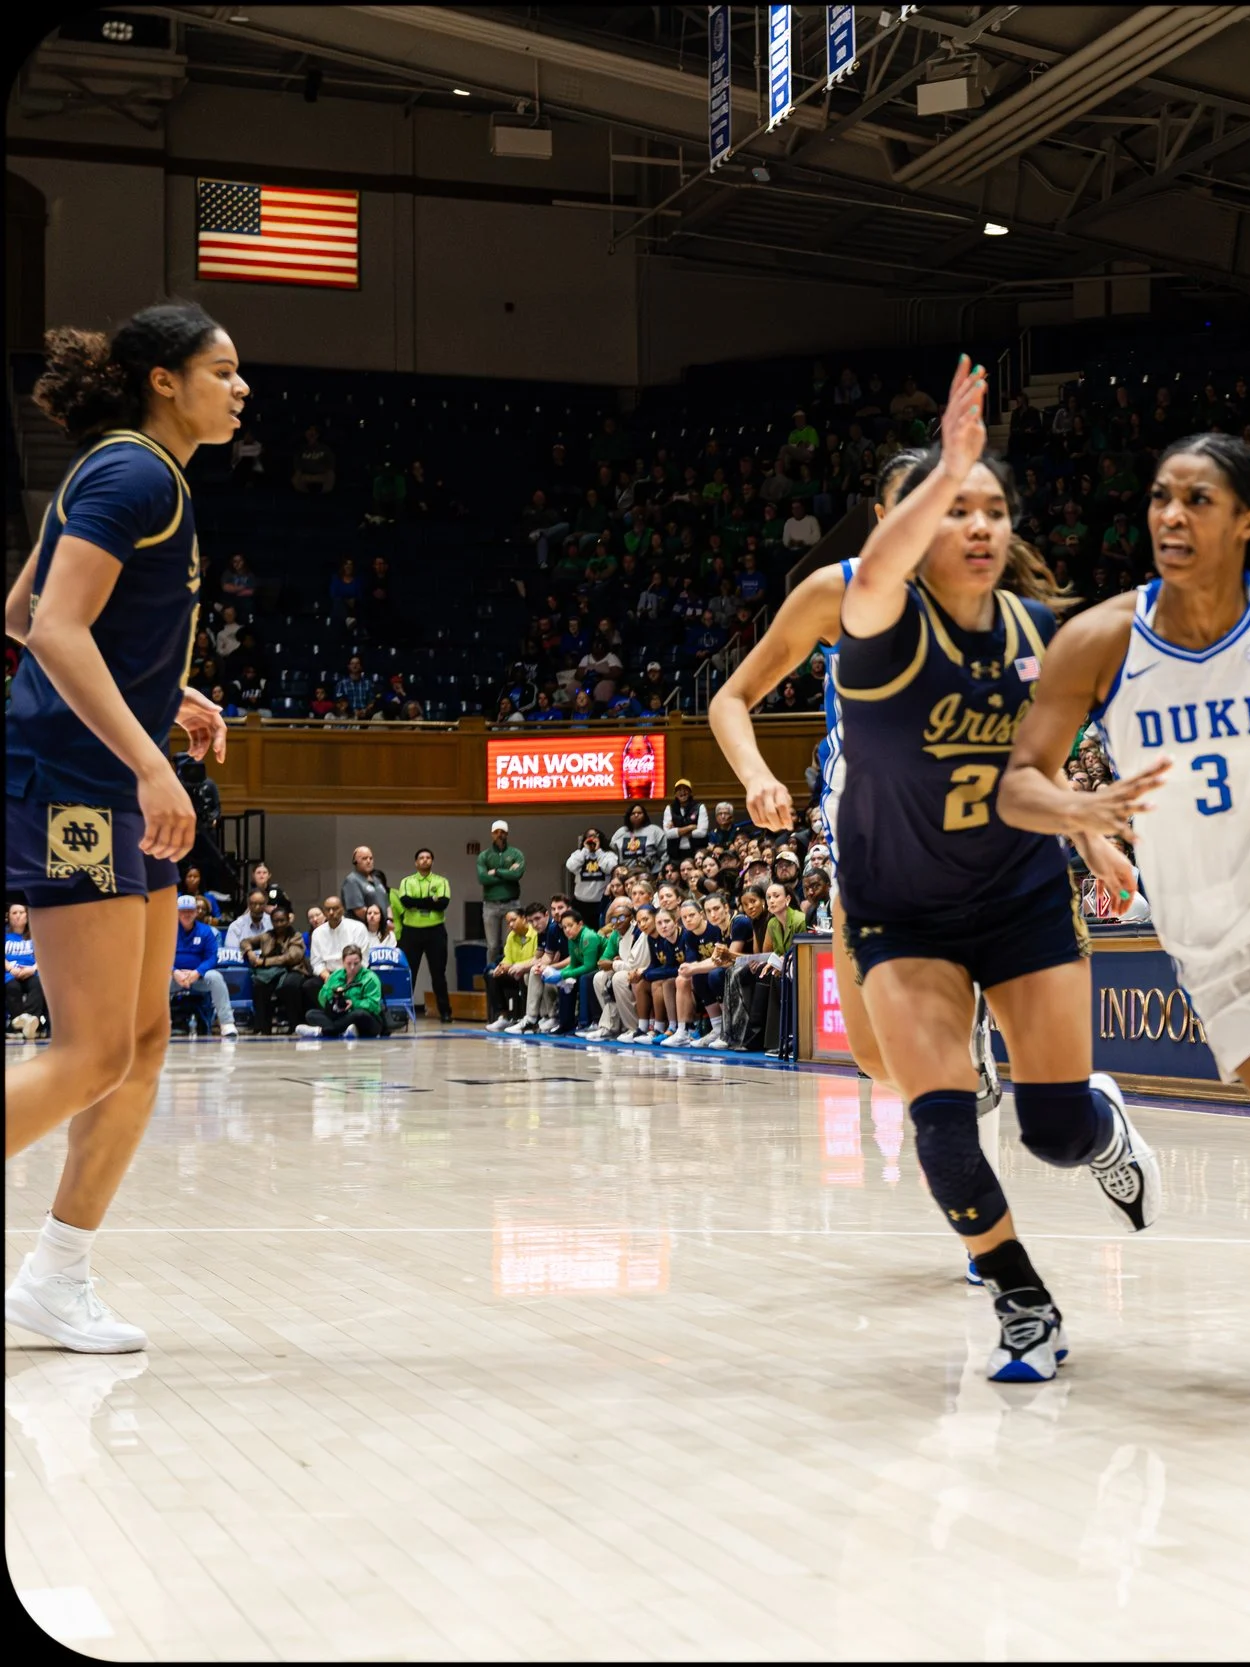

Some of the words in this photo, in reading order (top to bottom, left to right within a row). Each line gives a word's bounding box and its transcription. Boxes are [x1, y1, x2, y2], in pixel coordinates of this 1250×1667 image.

[496, 754, 539, 775] FAN
[543, 752, 615, 774] WORK
[497, 776, 509, 789] IS
[511, 775, 569, 789] THIRSTY
[570, 774, 615, 787] WORK
[1190, 753, 1233, 817] 3
[943, 764, 999, 832] 2
[371, 949, 399, 964] DUKE
